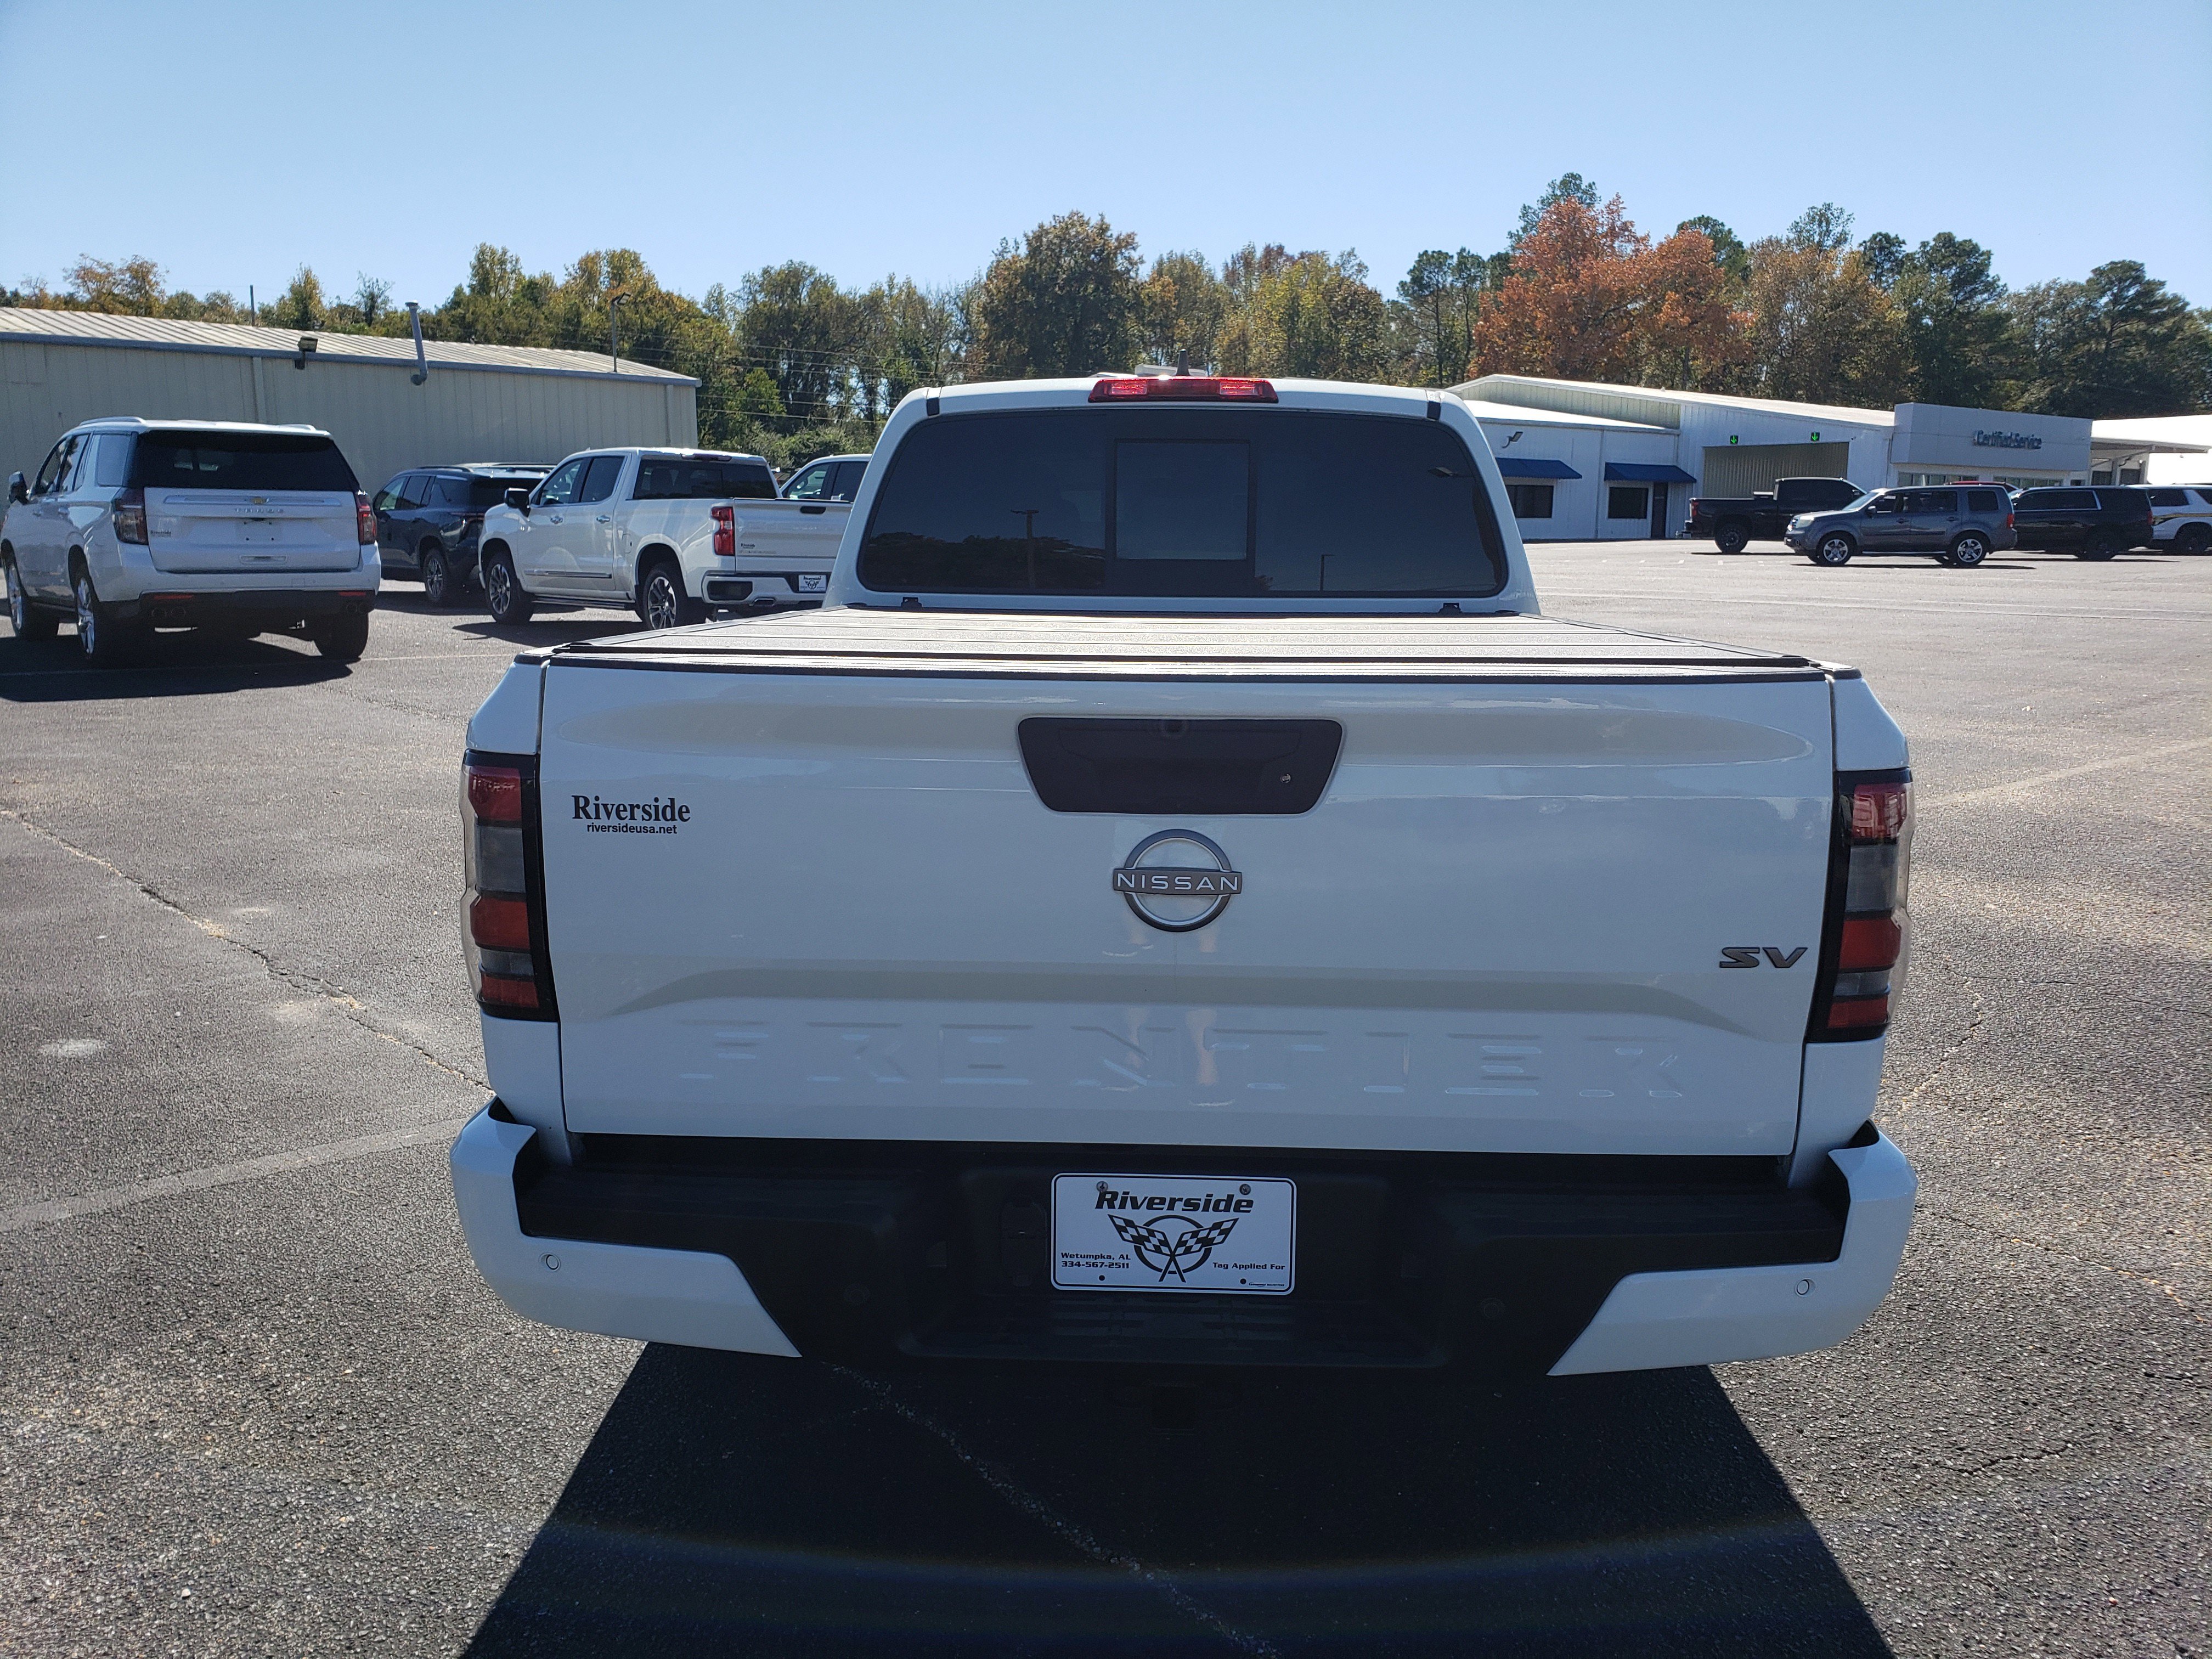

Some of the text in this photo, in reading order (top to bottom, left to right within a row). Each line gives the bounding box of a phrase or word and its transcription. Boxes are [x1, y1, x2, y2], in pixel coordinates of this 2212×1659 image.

[1976, 430, 2042, 449] Certified Service
[571, 794, 691, 822] Riverside
[586, 822, 678, 834] riversideusa.net
[1117, 873, 1238, 890] NISSAN
[1719, 946, 1808, 968] SV
[1094, 1190, 1254, 1213] Riverside
